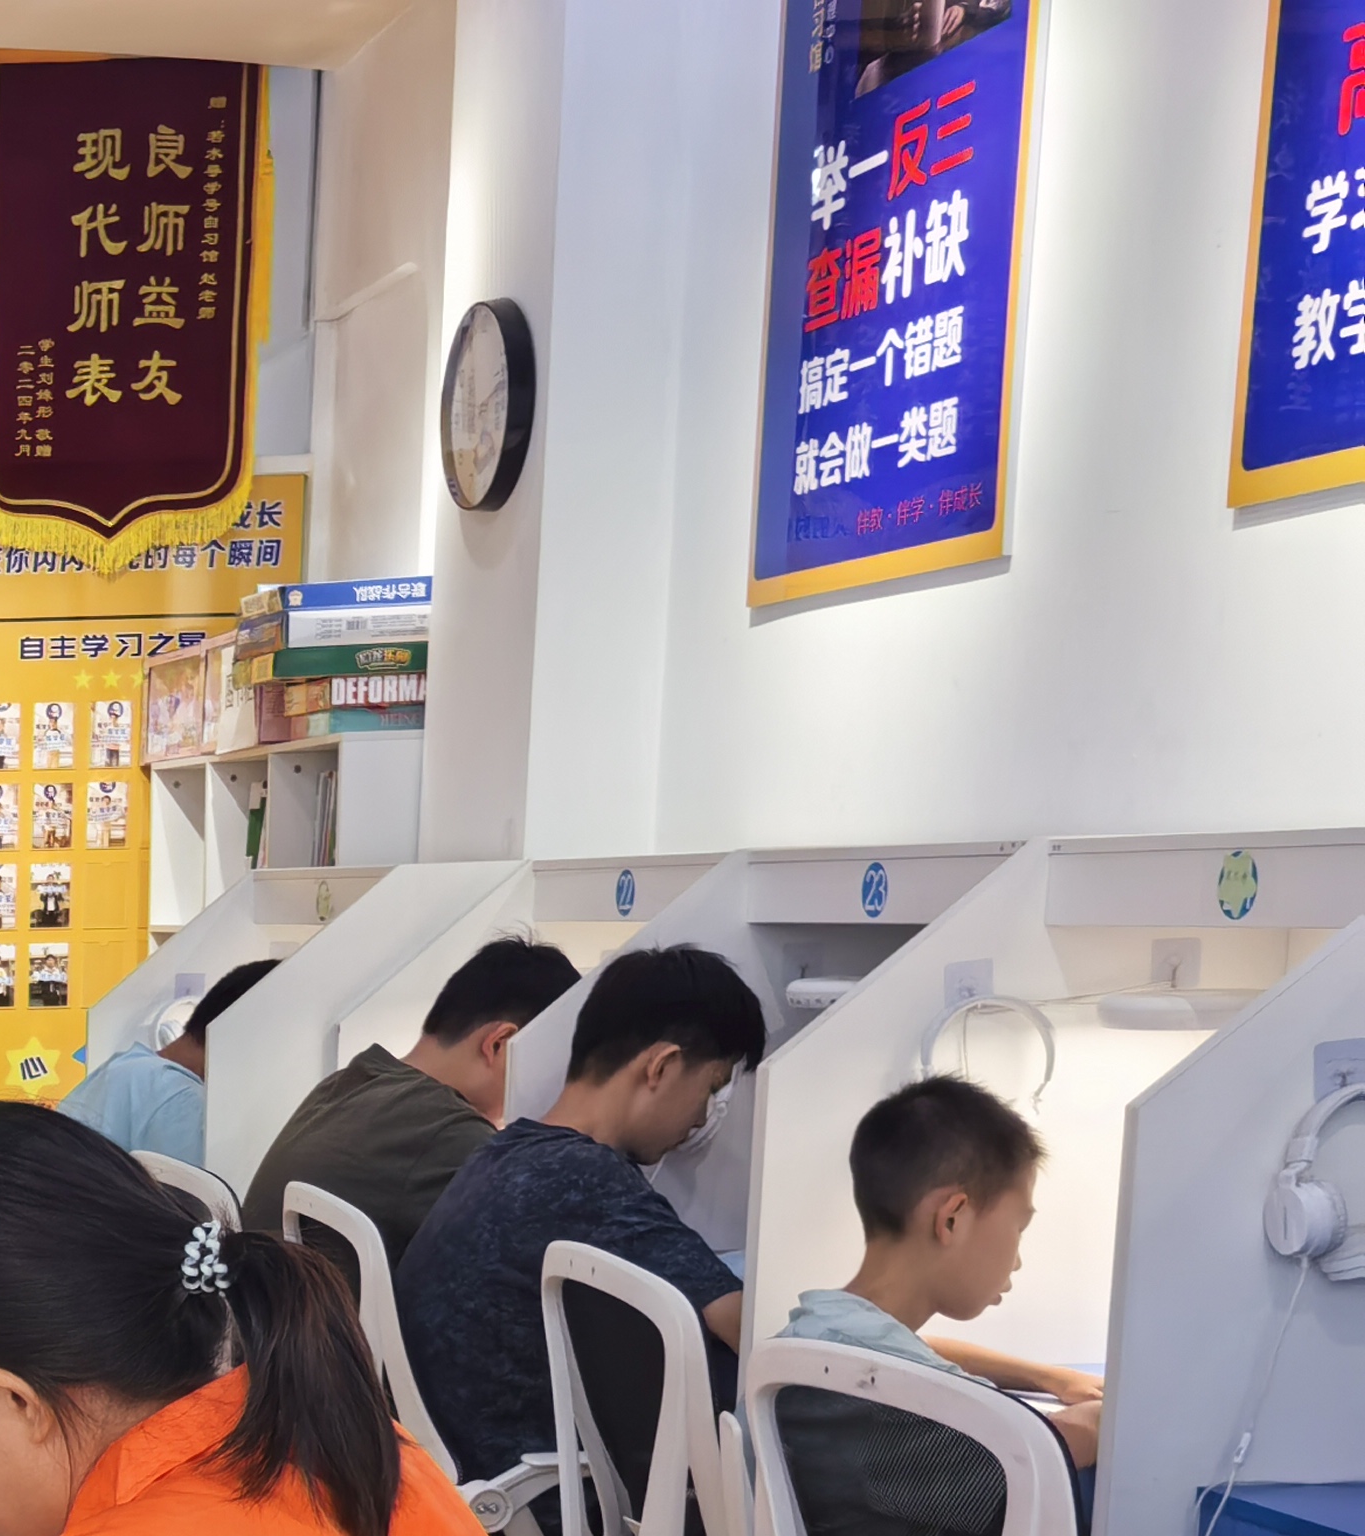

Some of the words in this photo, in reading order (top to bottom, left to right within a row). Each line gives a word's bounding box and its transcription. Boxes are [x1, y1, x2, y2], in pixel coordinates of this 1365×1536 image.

[810, 79, 977, 231] 举一反三
[65, 127, 131, 406] 现代师表
[130, 125, 193, 407] 良师益友
[803, 189, 970, 333] 查漏补缺
[14, 345, 35, 457] 二零二四年九月
[797, 304, 966, 415] 搞定一个错题
[793, 396, 959, 497] 就会做一类题
[19, 631, 207, 661] 自主学习之星
[619, 874, 632, 910] 22
[865, 869, 886, 911] 23
[20, 1056, 48, 1080] 心
